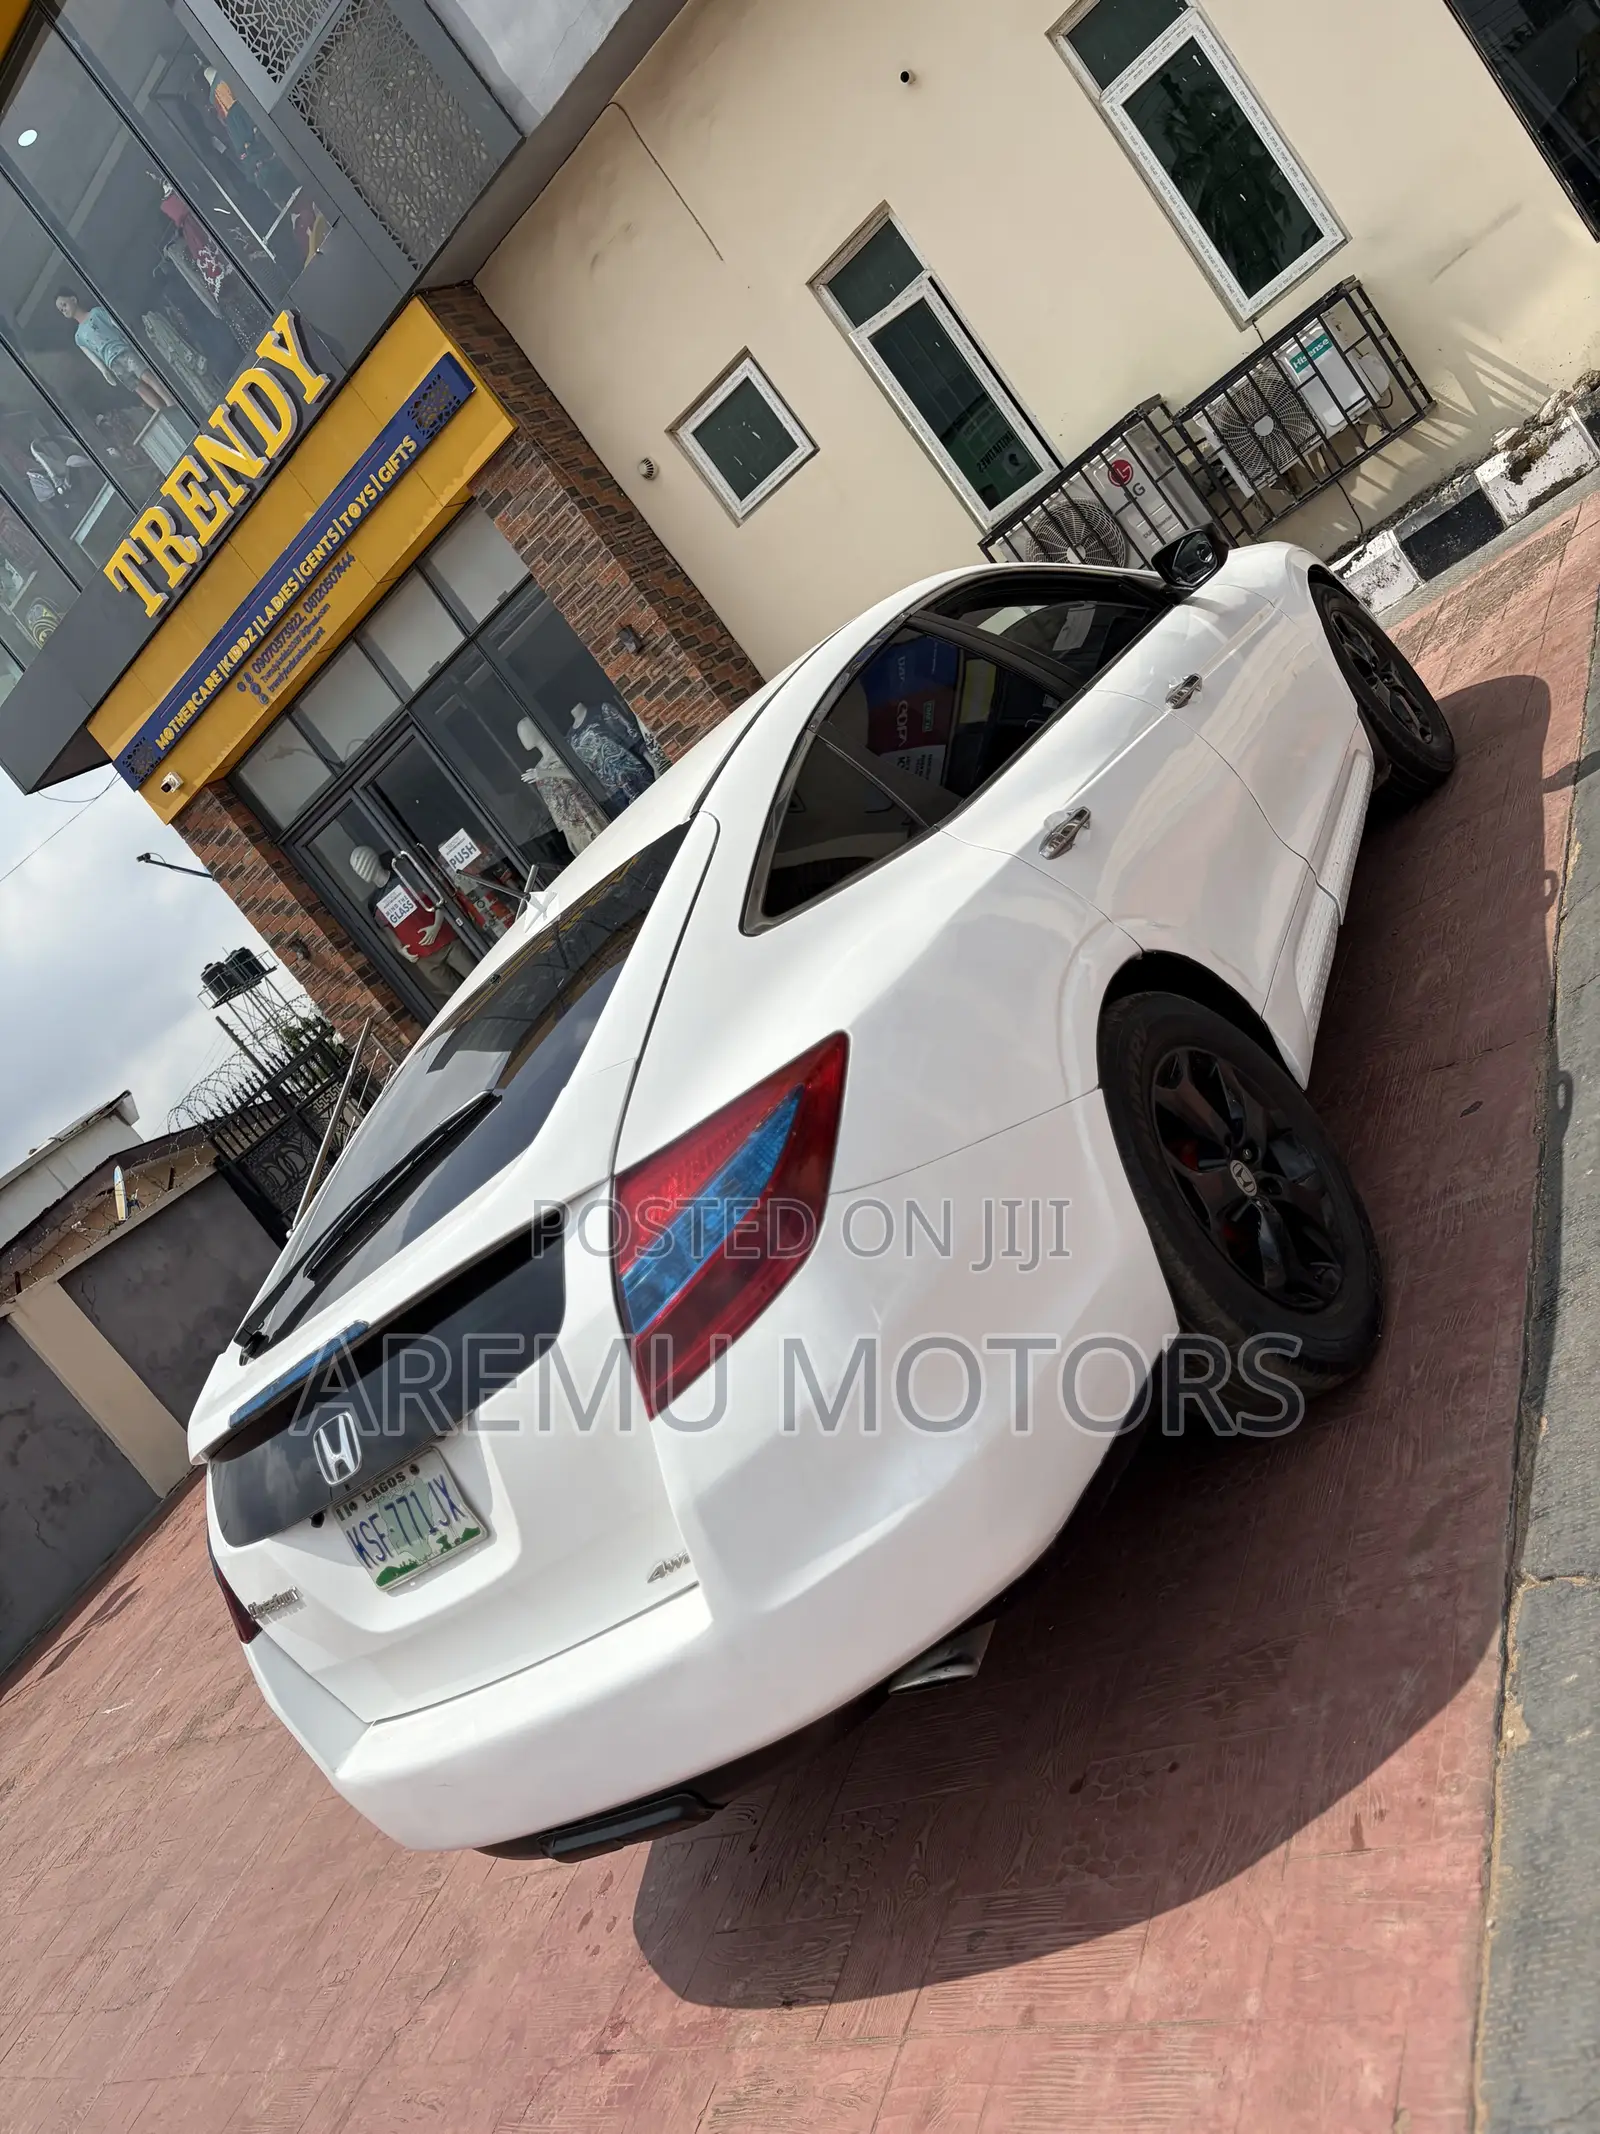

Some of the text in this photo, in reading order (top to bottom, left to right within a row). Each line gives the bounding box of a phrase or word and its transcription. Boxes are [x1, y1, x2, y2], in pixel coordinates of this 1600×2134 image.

[1293, 338, 1330, 369] Hisense
[104, 309, 331, 619] TRENDY
[155, 434, 417, 751] MOTHERCARE KIDDZ LADIES GENTS TOYS GIFTS
[449, 842, 477, 869] PUSH
[389, 900, 414, 923] GLASS
[362, 1471, 406, 1504] LAGOS
